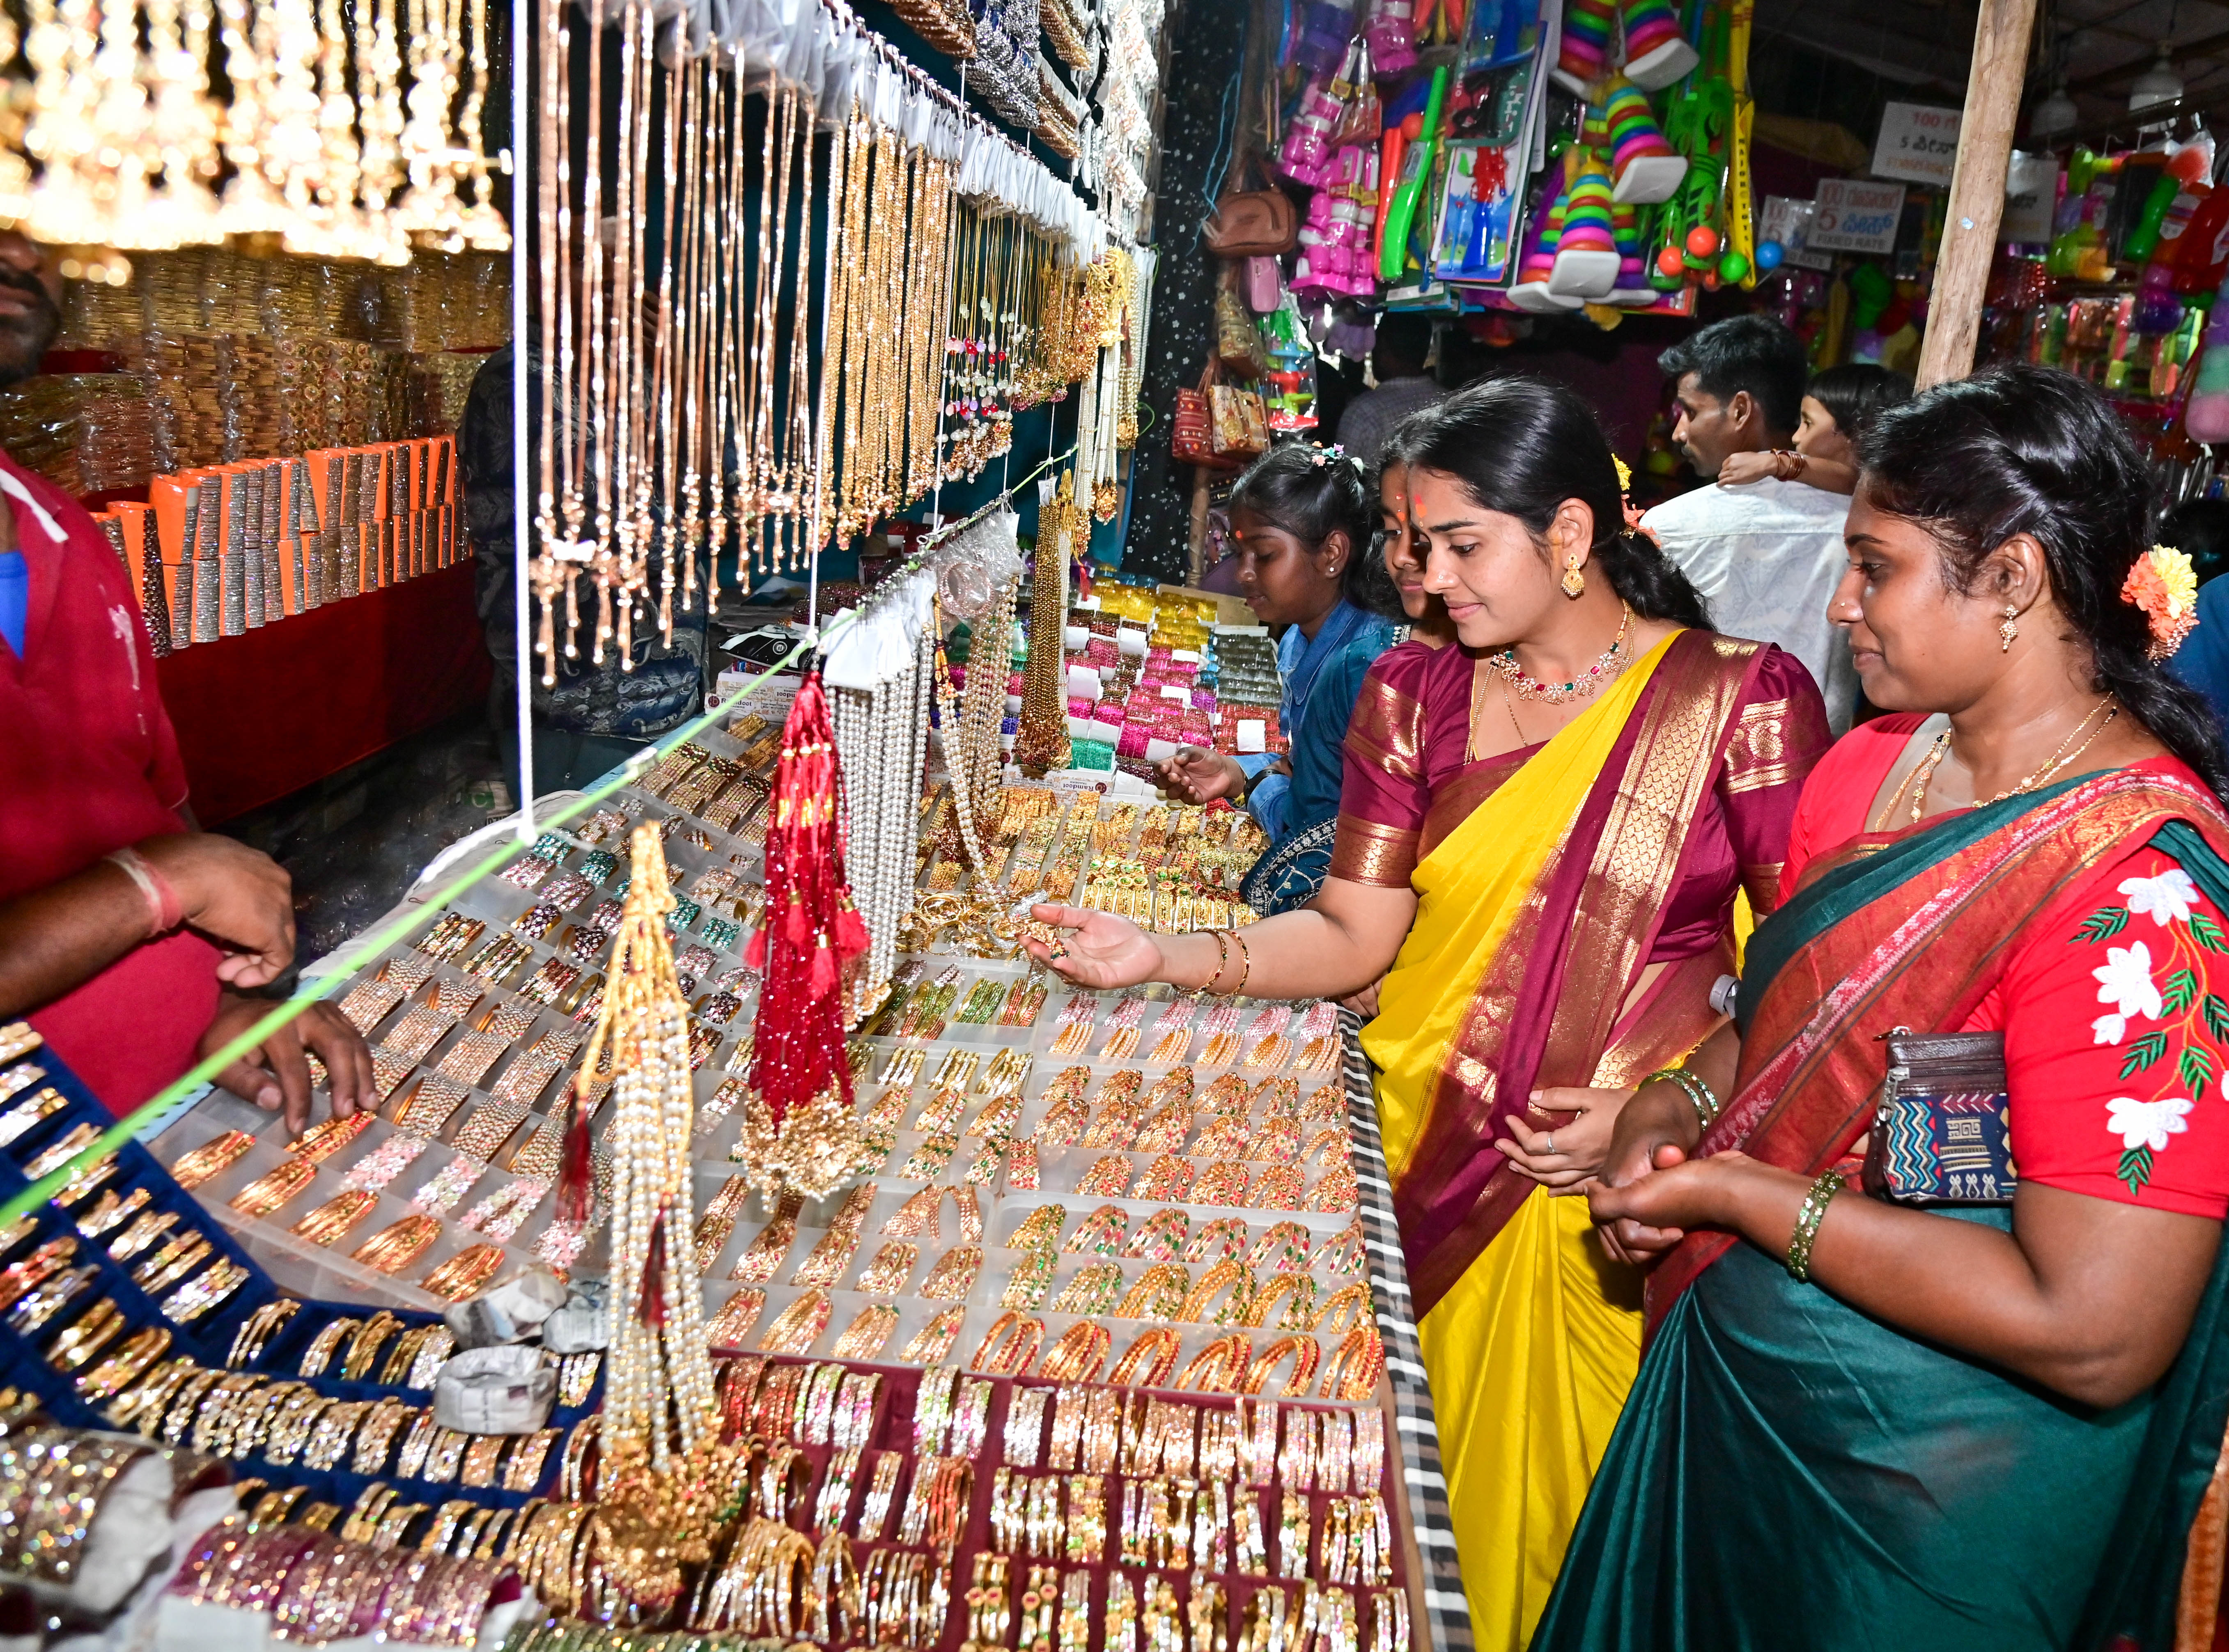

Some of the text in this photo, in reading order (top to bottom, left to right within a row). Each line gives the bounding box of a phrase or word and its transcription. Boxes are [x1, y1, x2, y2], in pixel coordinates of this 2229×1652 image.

[1816, 207, 1839, 231] 5
[721, 698, 752, 707] Rdoot
[1063, 783, 1094, 792] Ramdoot
